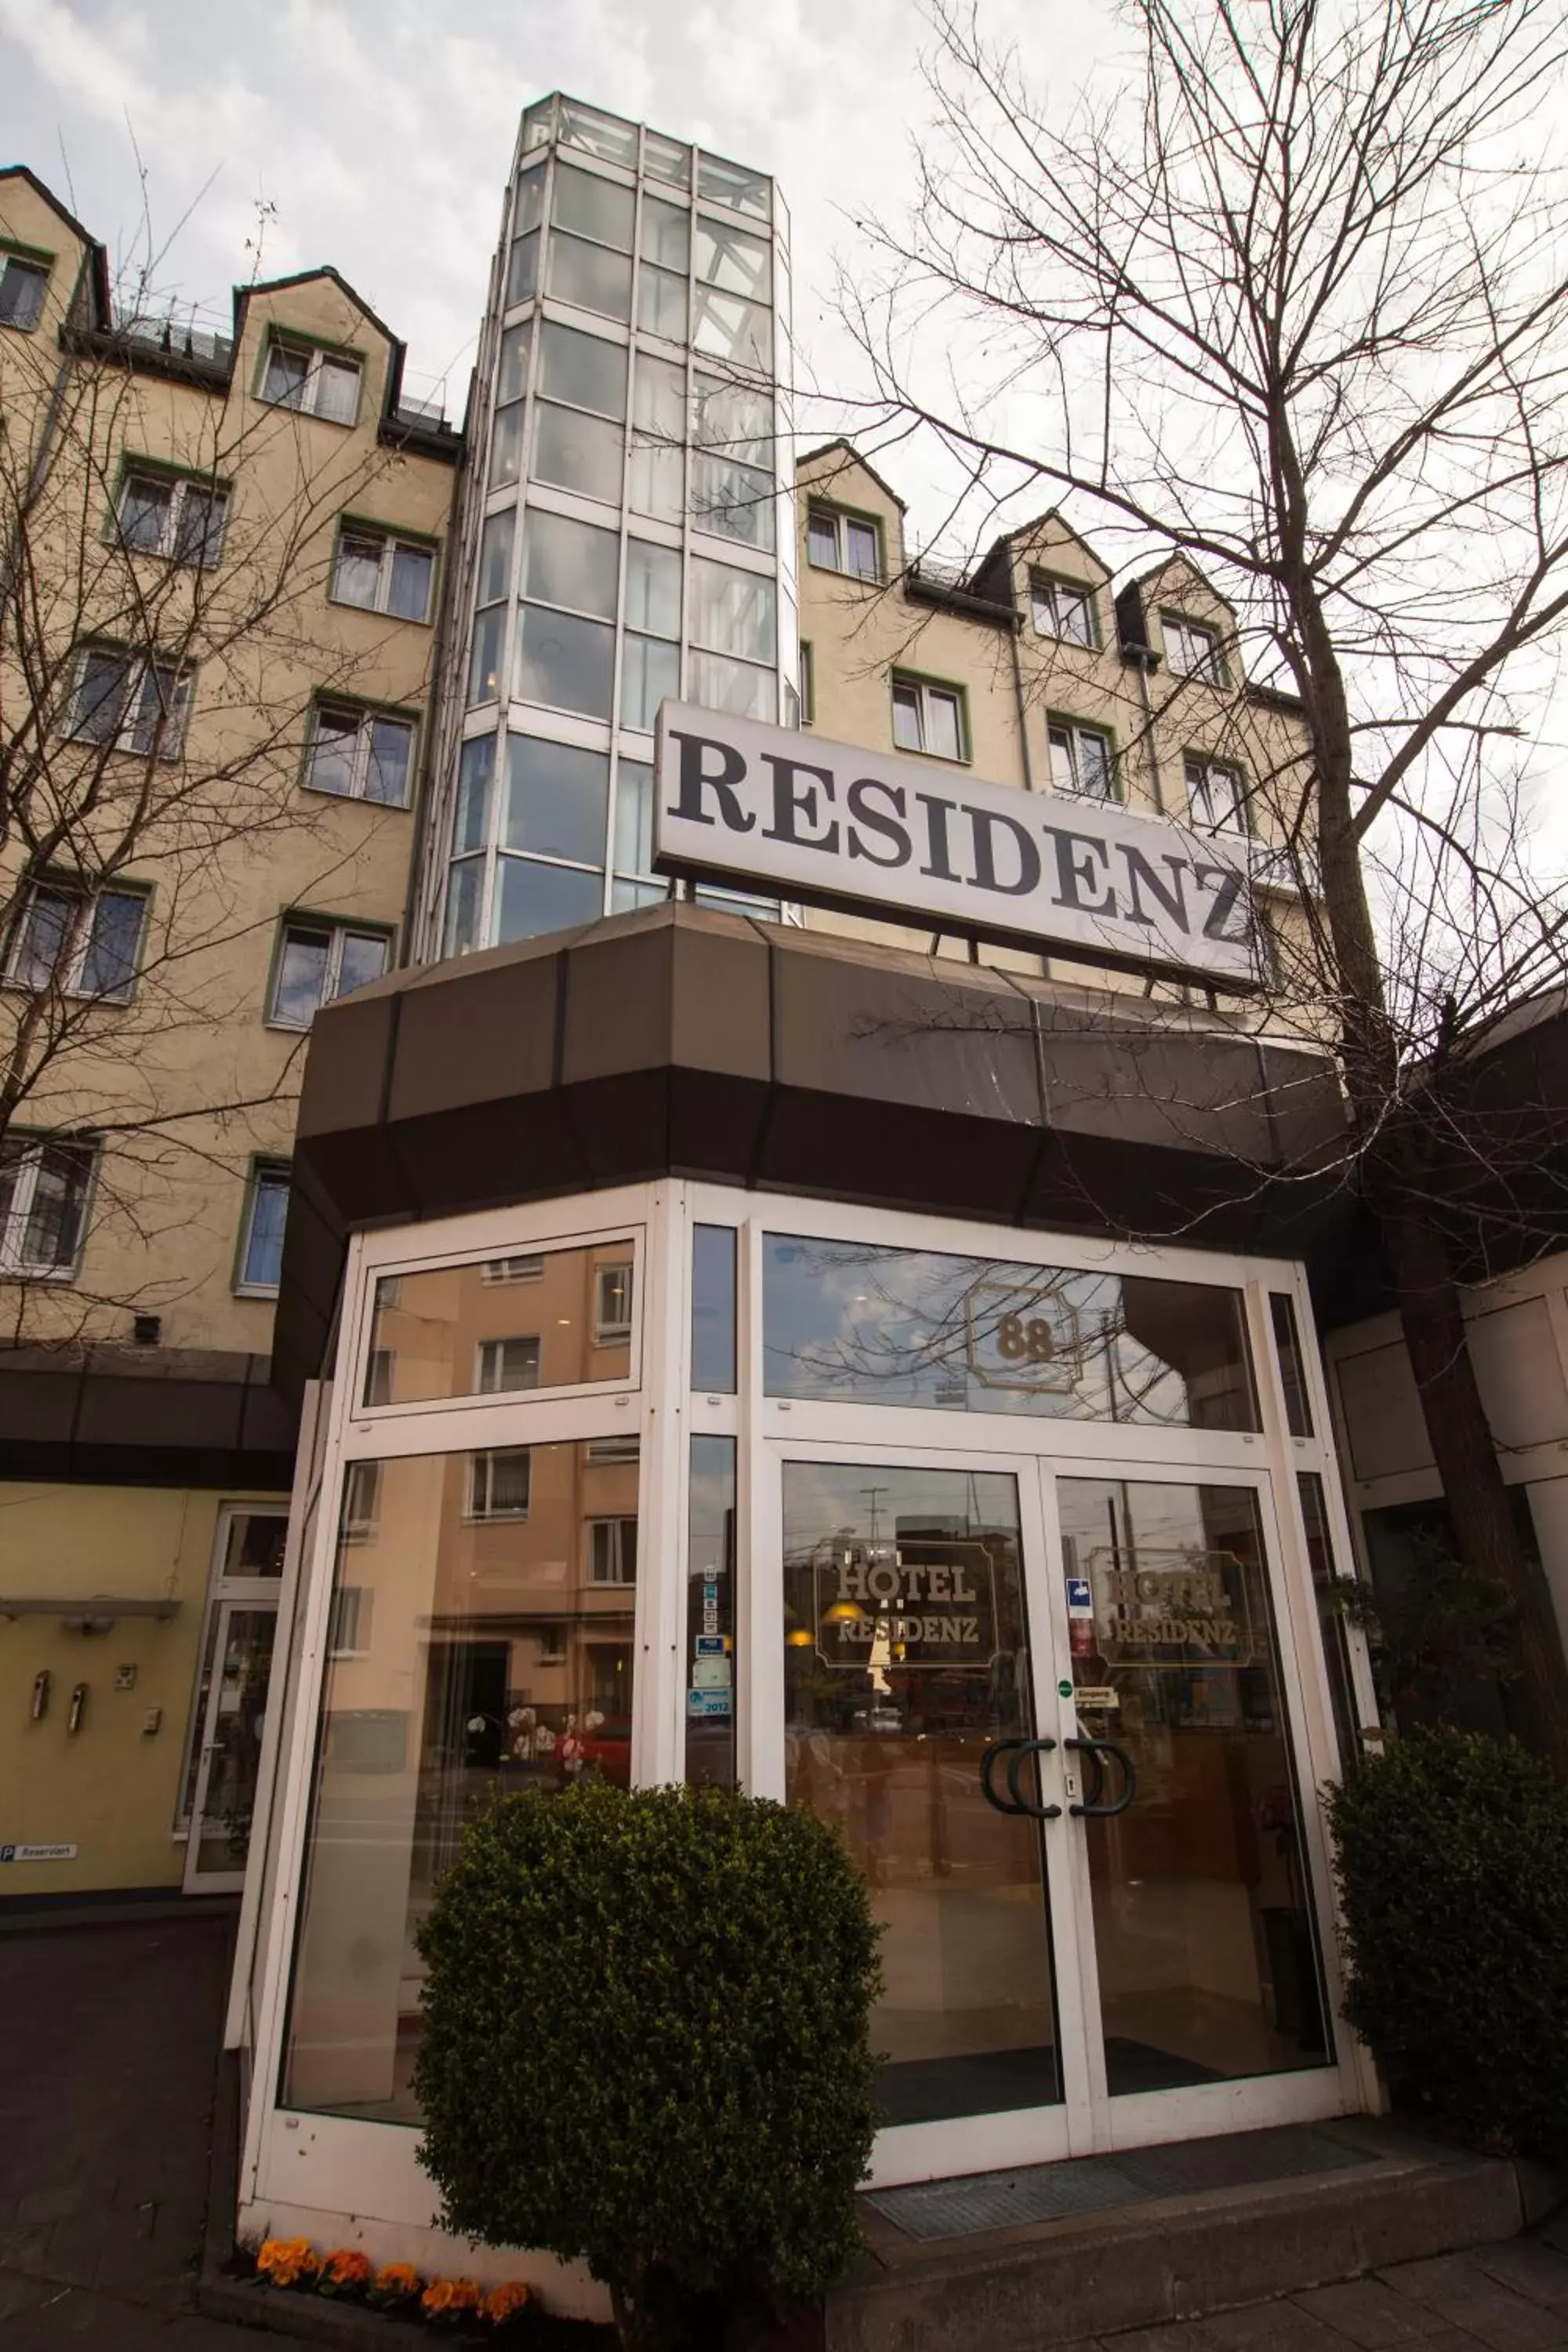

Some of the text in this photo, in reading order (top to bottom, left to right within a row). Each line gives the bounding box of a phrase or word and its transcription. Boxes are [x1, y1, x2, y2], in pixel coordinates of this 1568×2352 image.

[667, 731, 1253, 946] RESIDENZ
[998, 1312, 1054, 1359] 88
[837, 1562, 976, 1602] HOTEL
[1107, 1570, 1231, 1606] HOTEL
[838, 1616, 979, 1642] RESIDENZ
[1116, 1618, 1236, 1644] RESIDENZ
[705, 1702, 729, 1712] 2012
